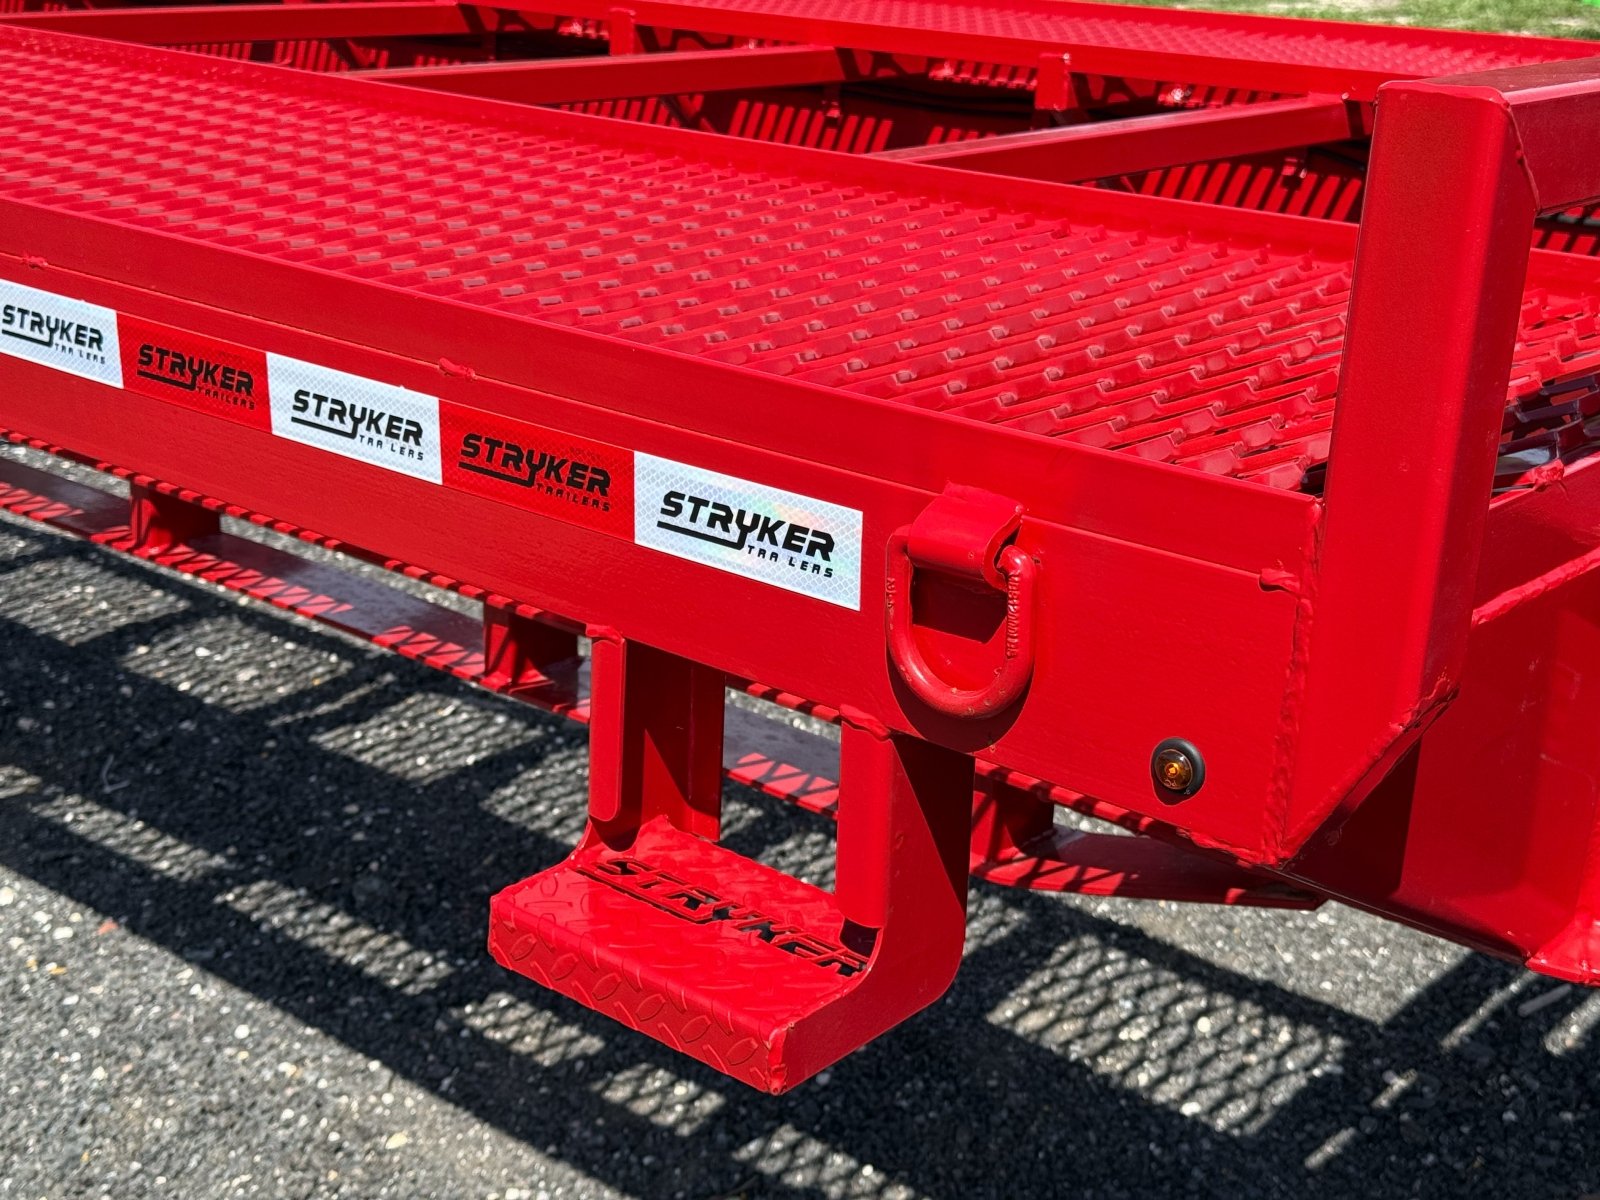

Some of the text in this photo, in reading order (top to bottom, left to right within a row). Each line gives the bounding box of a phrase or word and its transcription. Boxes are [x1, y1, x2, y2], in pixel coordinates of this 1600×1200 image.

[2, 304, 104, 352] STRYKER
[54, 343, 106, 365] TRALERS
[137, 343, 254, 396] STRYKER
[197, 386, 255, 410] TRAILERS
[291, 389, 423, 447] STRYKER
[359, 434, 424, 461] TRALERS
[458, 433, 611, 497] STRYKER
[536, 482, 610, 512] TRAILERS
[656, 490, 835, 562] STRYKER
[747, 544, 834, 578] TRALERS
